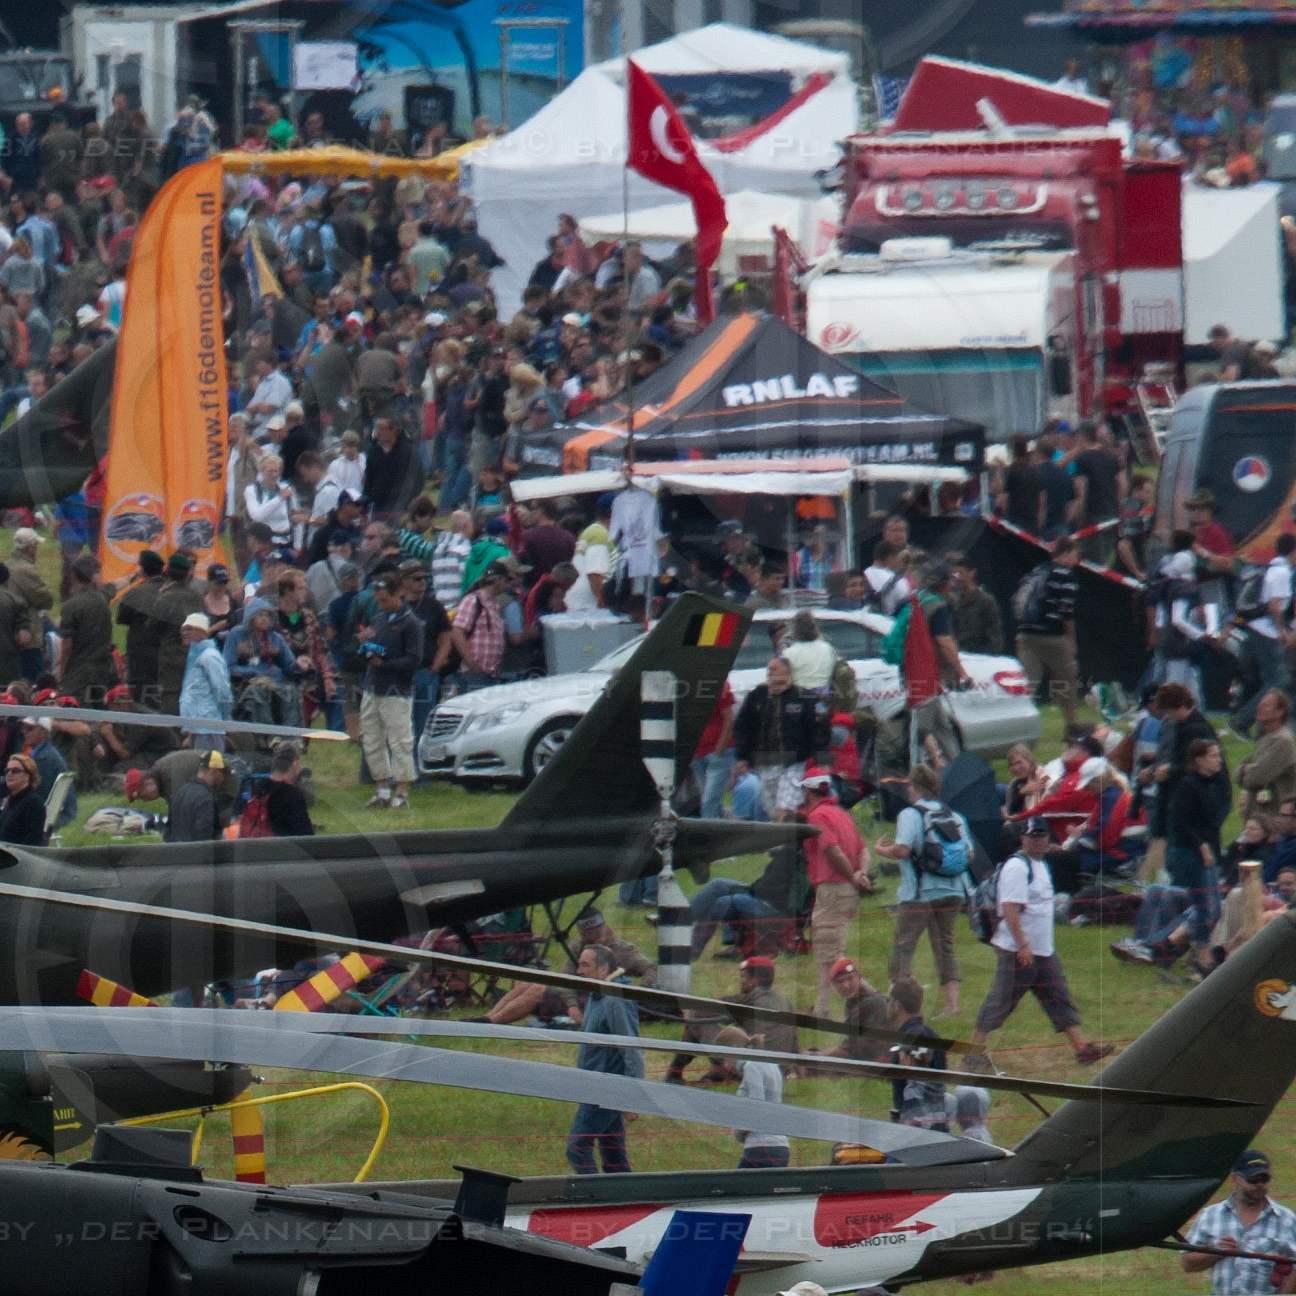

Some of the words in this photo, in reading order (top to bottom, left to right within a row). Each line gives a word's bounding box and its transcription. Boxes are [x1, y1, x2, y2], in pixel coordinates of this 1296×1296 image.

[196, 192, 223, 483] www.f16demoteam.nl
[722, 374, 860, 407] RNLAF
[844, 1212, 894, 1225] GEFAHR
[831, 1233, 907, 1250] HECKROTOR
